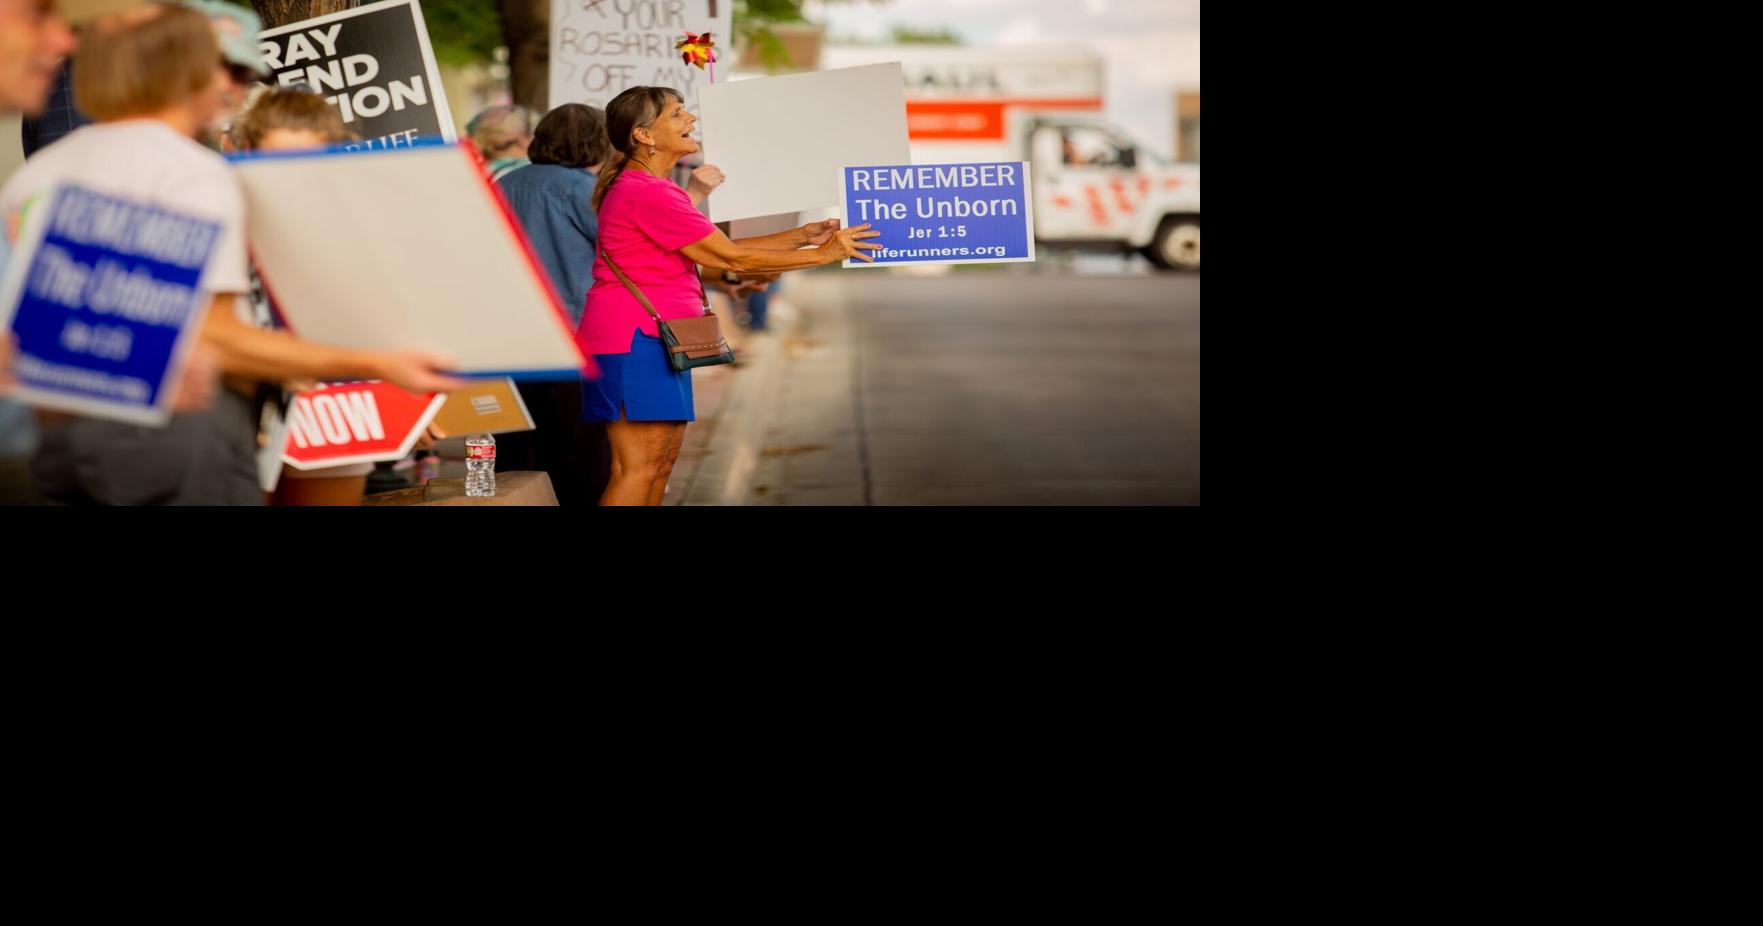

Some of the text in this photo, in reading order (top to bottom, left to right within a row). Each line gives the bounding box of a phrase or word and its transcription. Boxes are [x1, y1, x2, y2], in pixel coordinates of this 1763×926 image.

[614, 0, 686, 30] YOUR
[261, 23, 343, 69] RAY
[582, 64, 698, 97] OFF MY
[853, 165, 1016, 191] REMEMBER
[855, 196, 1018, 221] The Unborn
[908, 225, 967, 239] Jer 1:5
[871, 245, 1006, 259] liferunners.org
[286, 390, 386, 449] NOW
